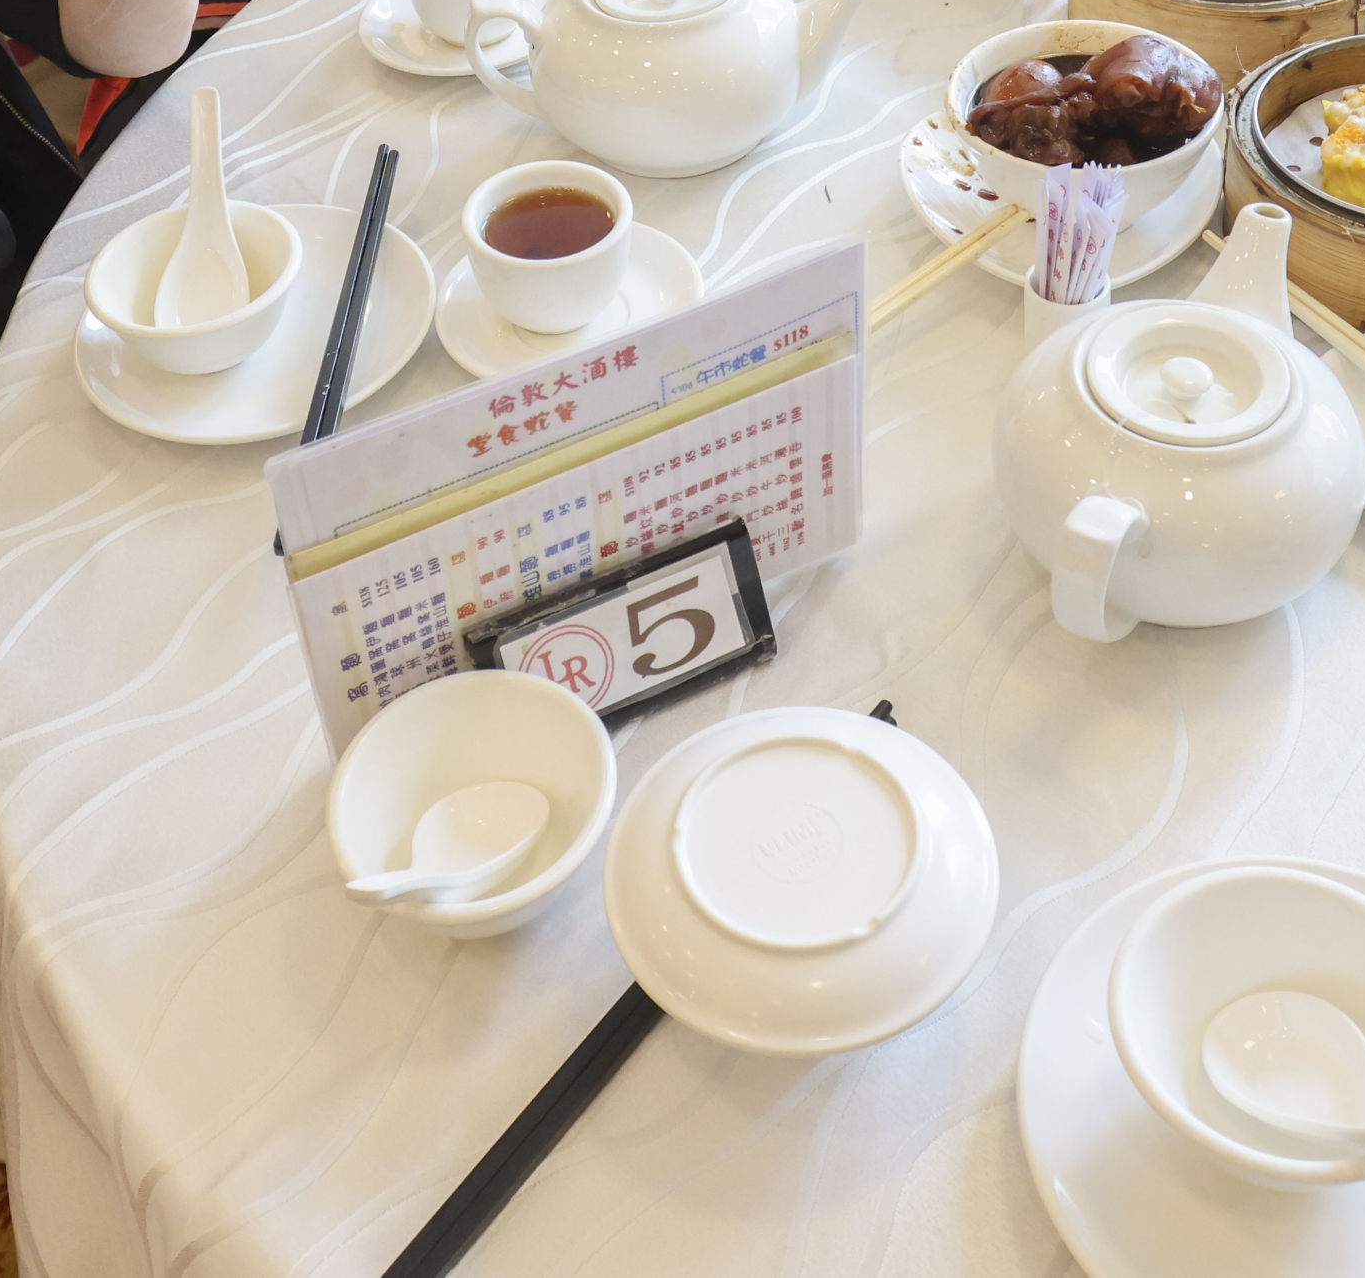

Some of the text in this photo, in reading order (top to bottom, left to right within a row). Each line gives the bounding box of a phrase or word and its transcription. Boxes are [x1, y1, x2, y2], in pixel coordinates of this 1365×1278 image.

[773, 324, 810, 352] $118
[488, 344, 639, 420] 倫敦大酒樓
[776, 410, 786, 425] 85
[790, 404, 802, 424] 100
[746, 423, 756, 437] 85
[761, 417, 772, 431] 85
[715, 435, 726, 450] 85
[730, 429, 741, 444] 85
[685, 449, 695, 463] 85
[700, 442, 711, 457] 85
[654, 461, 665, 476] 92
[669, 455, 680, 470] 85
[638, 468, 649, 483] 92
[558, 502, 569, 516] 95
[574, 495, 586, 510] 88
[542, 508, 554, 523] 88
[476, 535, 488, 550] 90
[493, 528, 505, 543] 90
[410, 563, 423, 583] 105
[427, 556, 440, 576] 160
[376, 577, 389, 598] 125
[393, 570, 407, 591] 105
[359, 585, 371, 608] $138
[626, 575, 716, 679] 5
